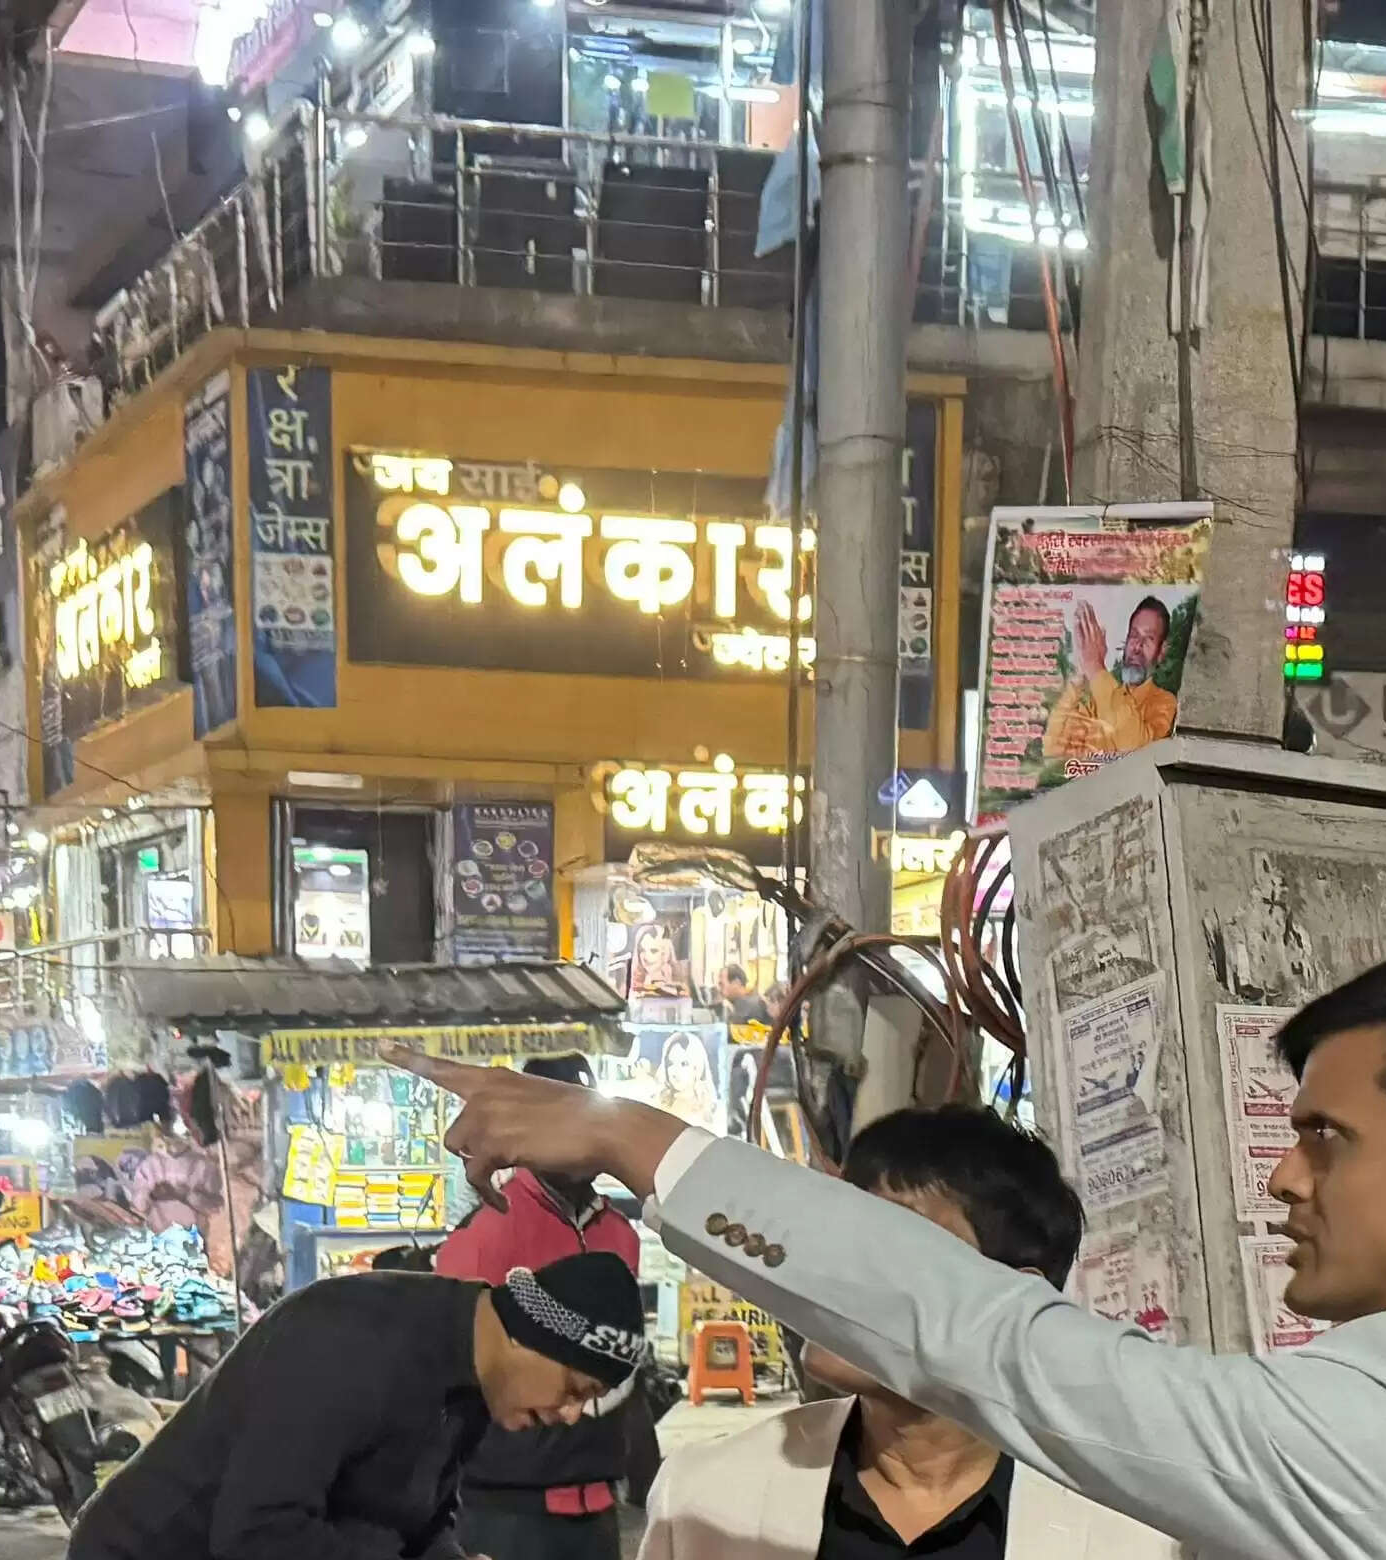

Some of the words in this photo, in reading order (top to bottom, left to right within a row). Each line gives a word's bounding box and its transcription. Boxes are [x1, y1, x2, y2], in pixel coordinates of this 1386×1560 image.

[371, 453, 453, 494] जय
[396, 483, 817, 622] अलंकार
[271, 1034, 294, 1062] ALL
[440, 1032, 463, 1057] ALL
